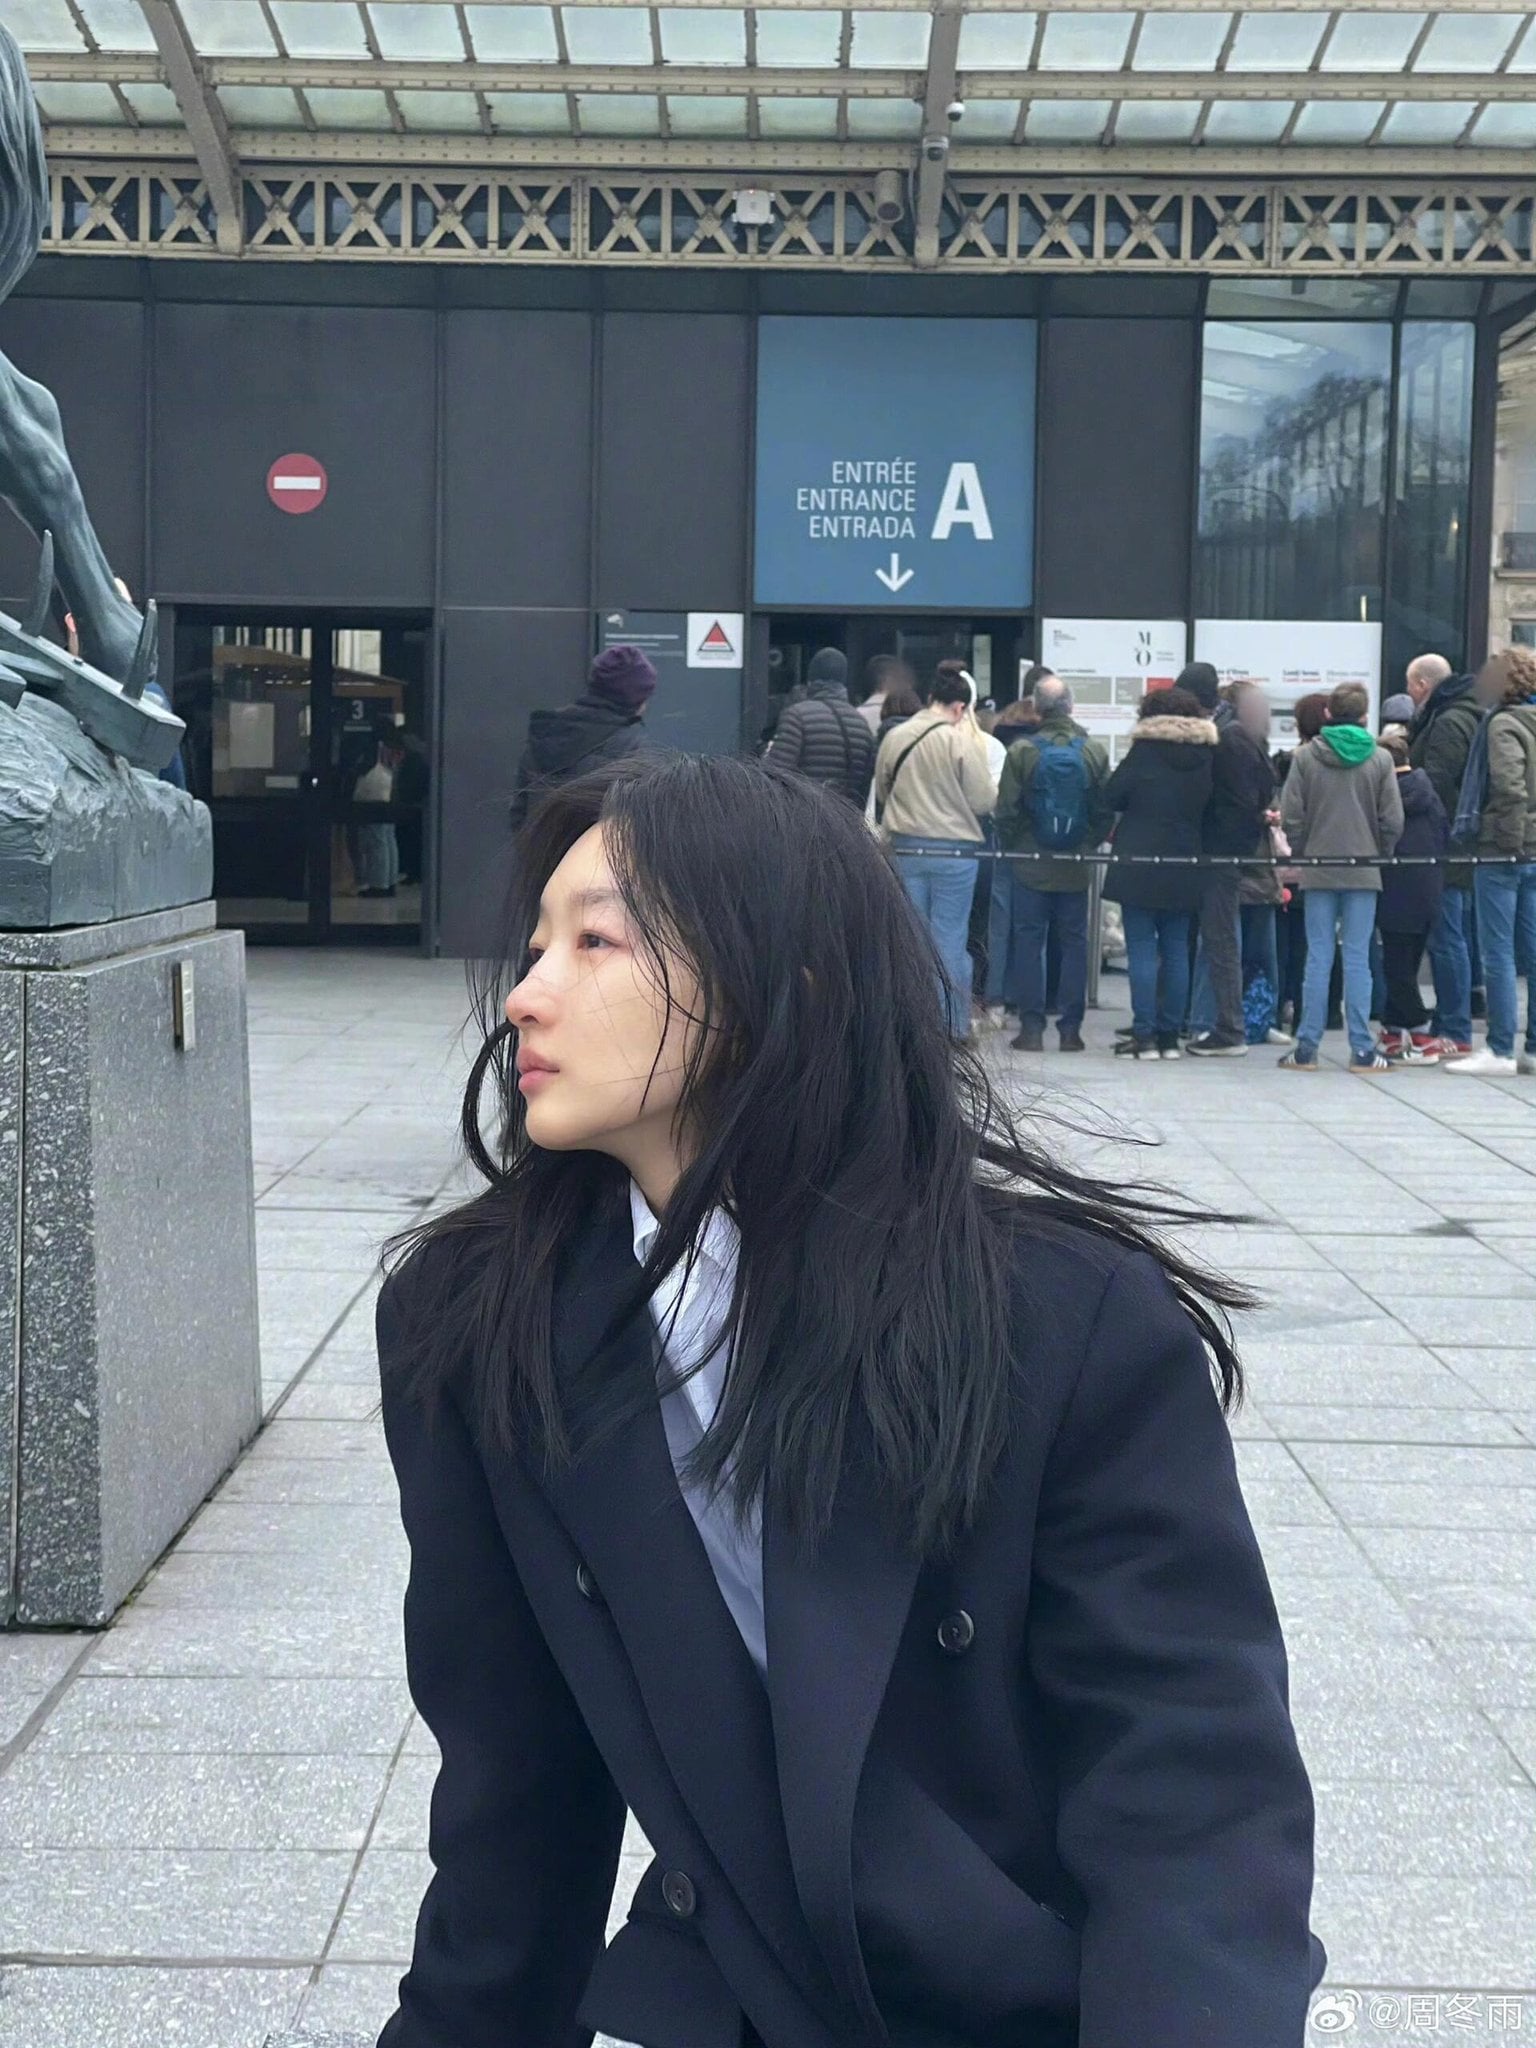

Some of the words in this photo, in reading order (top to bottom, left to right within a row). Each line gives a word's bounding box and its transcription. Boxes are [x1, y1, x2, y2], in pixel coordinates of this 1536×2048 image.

[832, 457, 917, 485] ENTRÉE
[796, 488, 916, 512] ENTRANCE
[931, 462, 994, 540] A
[808, 516, 916, 539] ENTRADA
